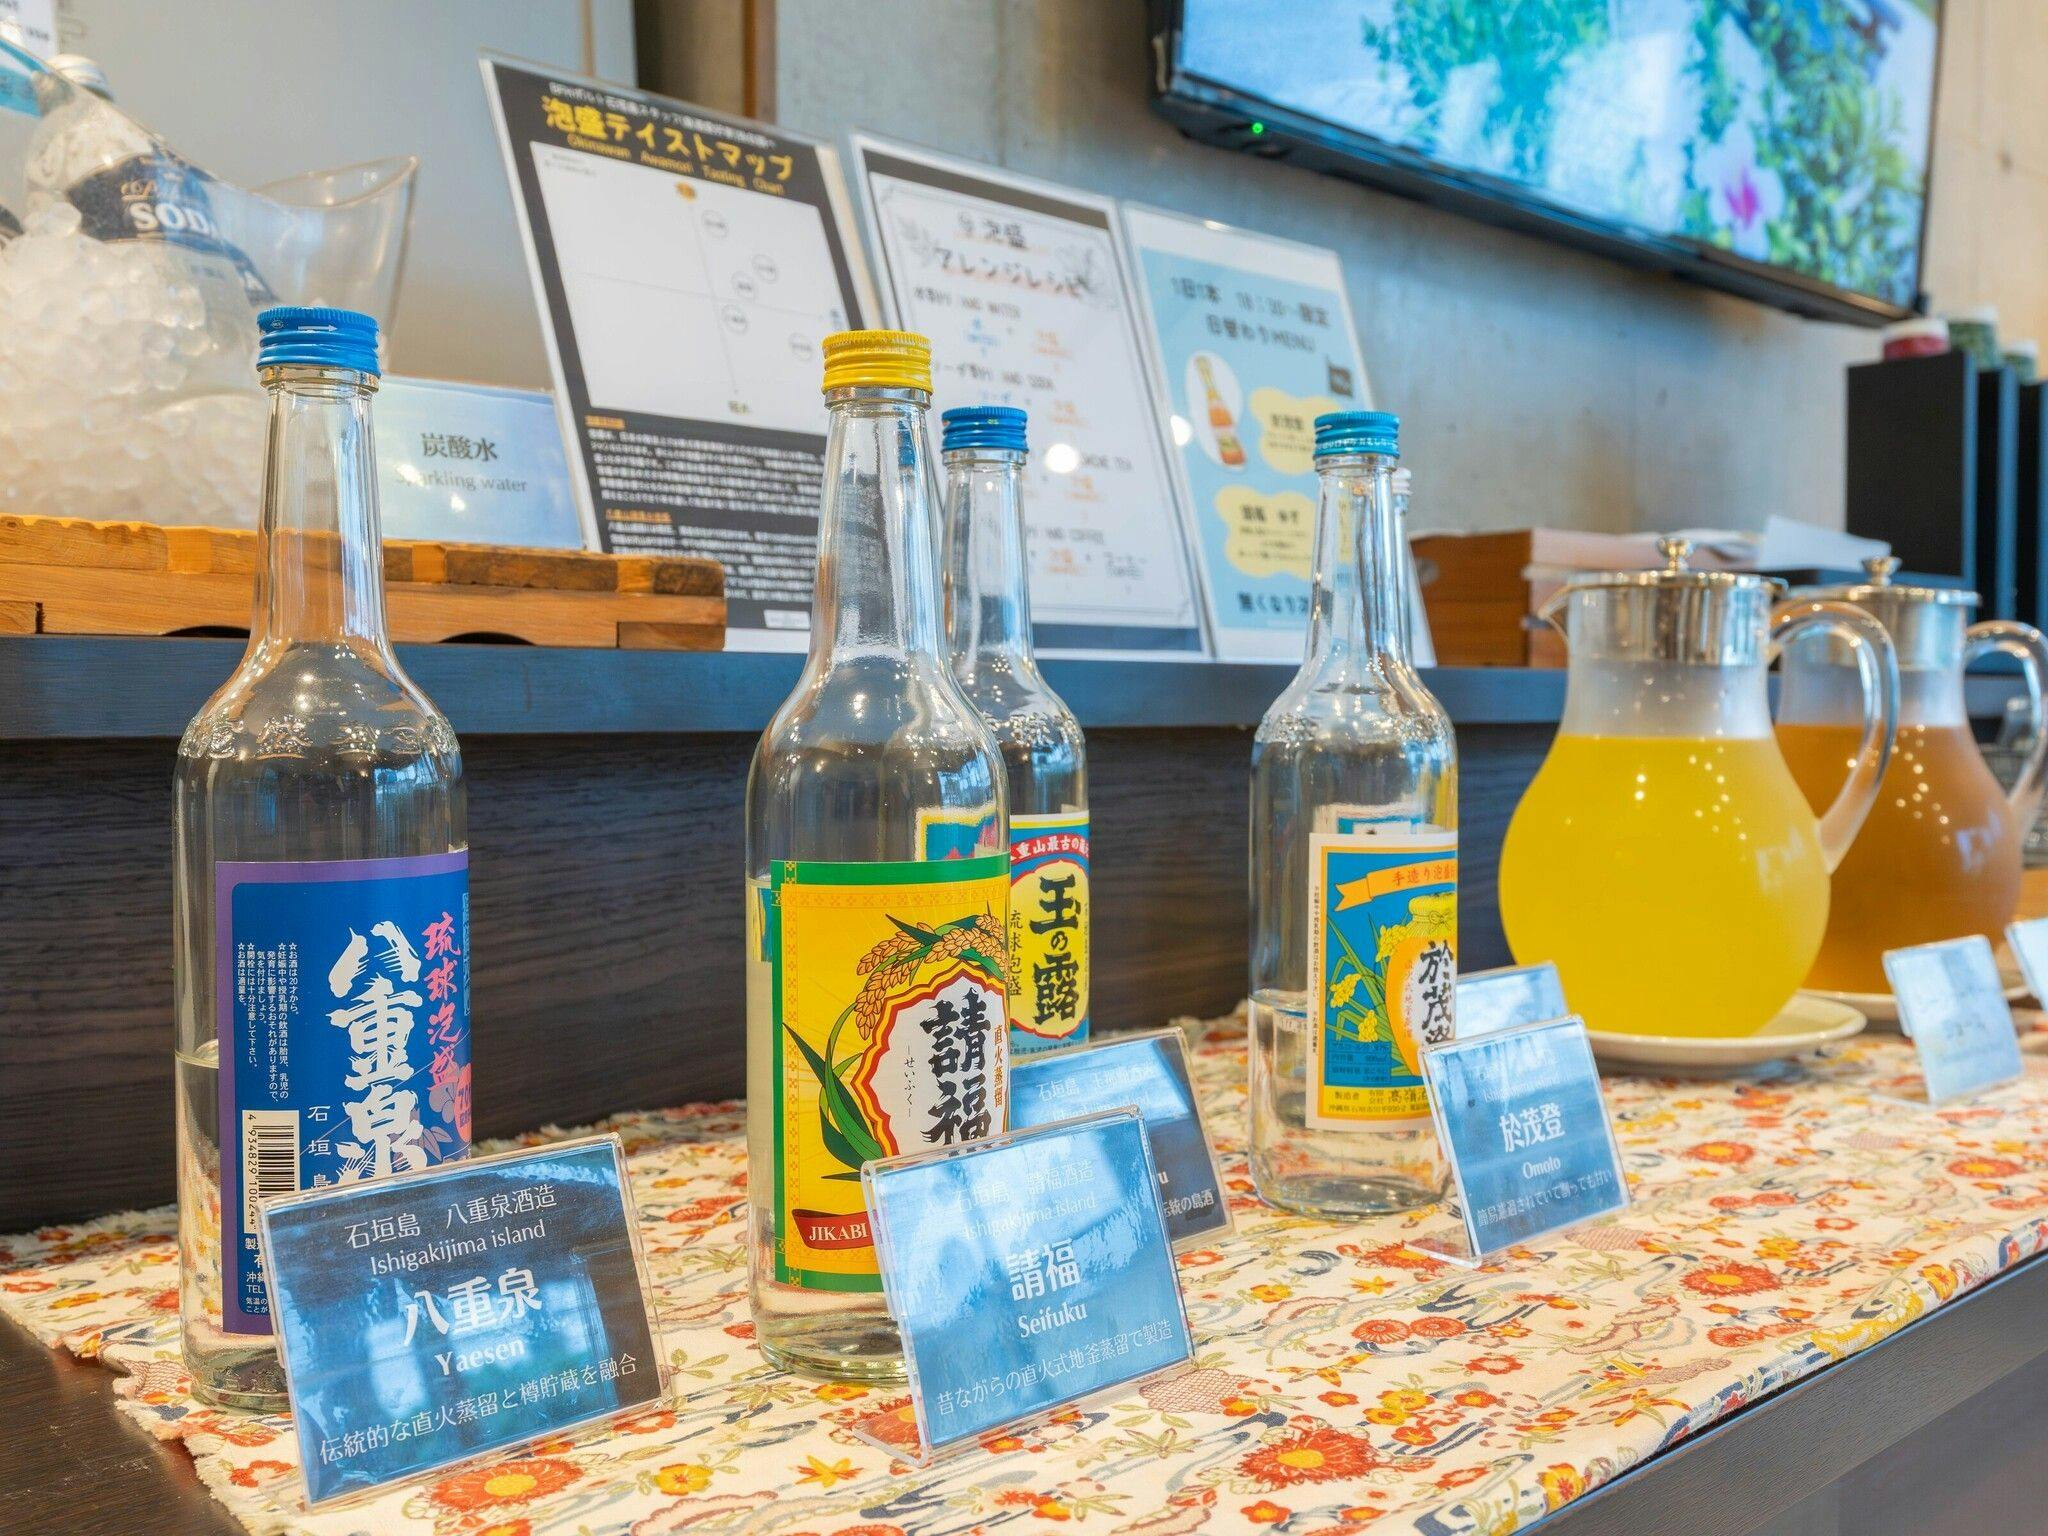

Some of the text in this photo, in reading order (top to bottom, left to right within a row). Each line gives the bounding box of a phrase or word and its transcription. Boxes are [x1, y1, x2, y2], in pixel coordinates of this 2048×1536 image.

[421, 432, 498, 462] 炭酸水
[481, 476, 528, 492] water
[1029, 872, 1082, 1026] 玉の露
[421, 911, 462, 1091] 琉球泡盛
[326, 920, 428, 1182] 八重泉
[919, 987, 992, 1145] 請福
[1499, 1103, 1565, 1152] 於茂登
[1522, 1156, 1561, 1180] Omoto
[345, 1184, 558, 1249] 石垣島 八重泉酒造
[809, 1222, 868, 1241] JIKABI
[370, 1219, 546, 1276] Ishigakijima island
[1005, 1238, 1082, 1303] 請福
[246, 1284, 264, 1294] TEL
[403, 1267, 543, 1347] 八重泉
[1016, 1302, 1089, 1339] Seifuku
[434, 1337, 526, 1376] Yaesen
[936, 1318, 1174, 1417] 昔ながらの直火式地釜蒸留で製造
[319, 1353, 637, 1467] 伝統的な直火蒸留と樽貯蔵を融合
